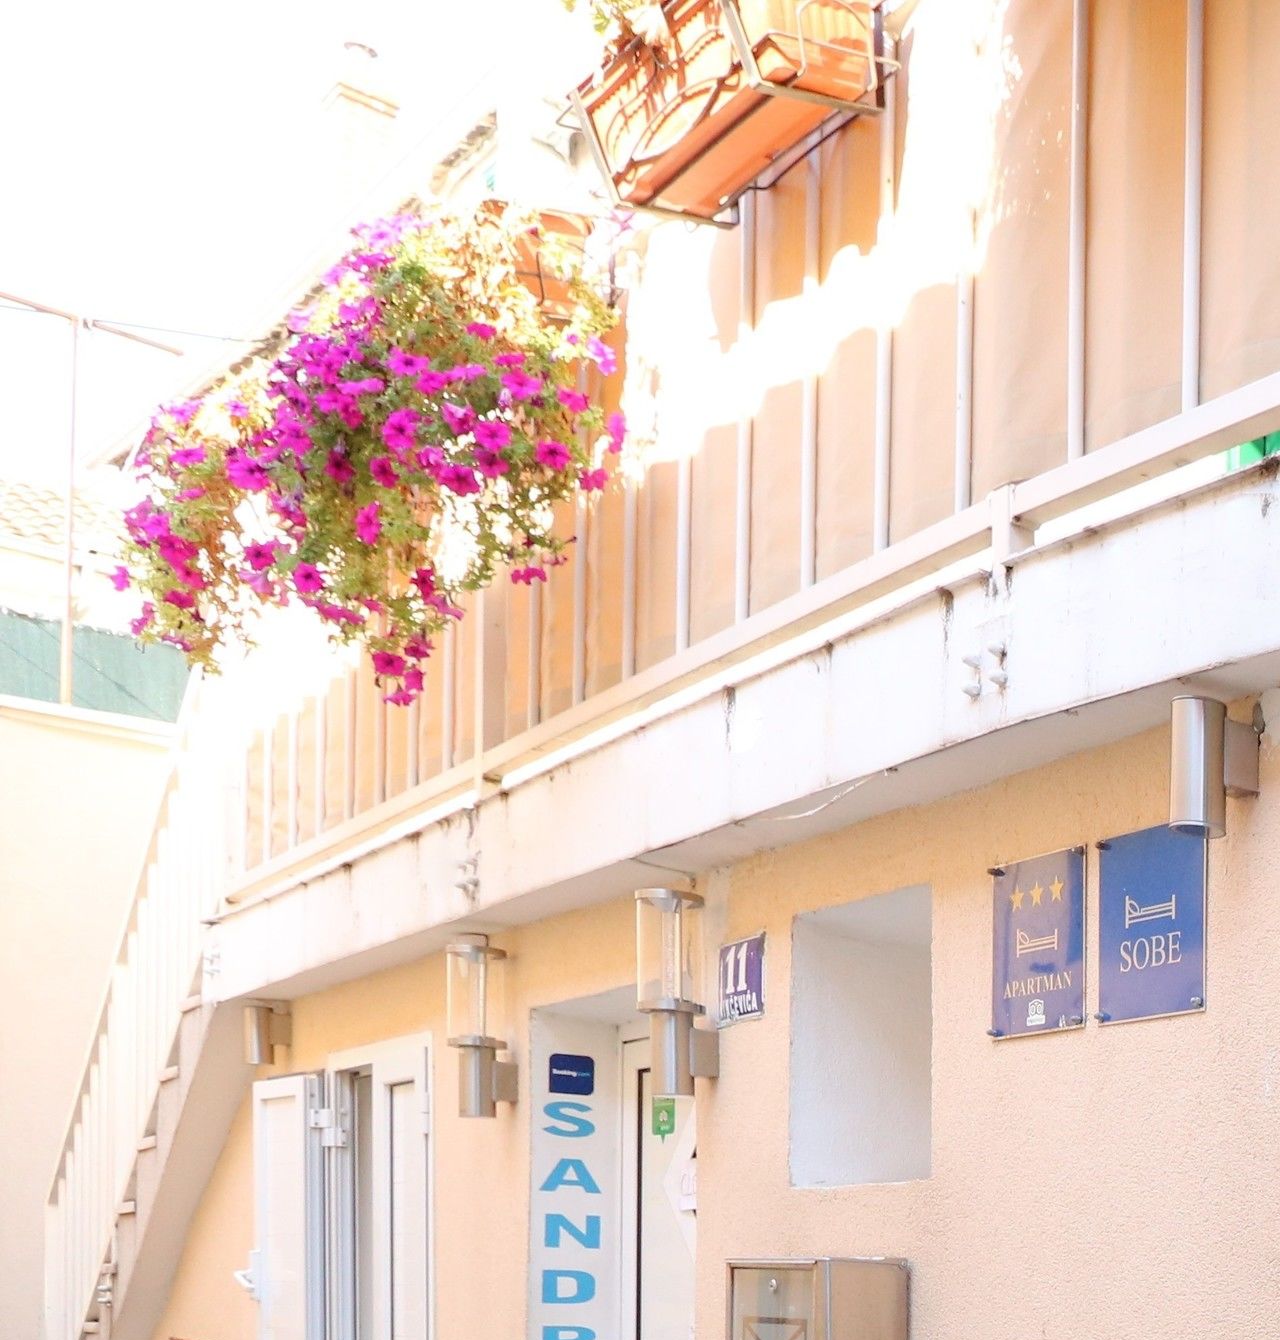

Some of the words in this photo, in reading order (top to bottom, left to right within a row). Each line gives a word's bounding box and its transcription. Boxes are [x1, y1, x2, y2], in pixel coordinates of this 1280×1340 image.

[726, 942, 748, 994] 11
[1120, 931, 1182, 972] SOBE
[1003, 971, 1072, 999] APARTMAN
